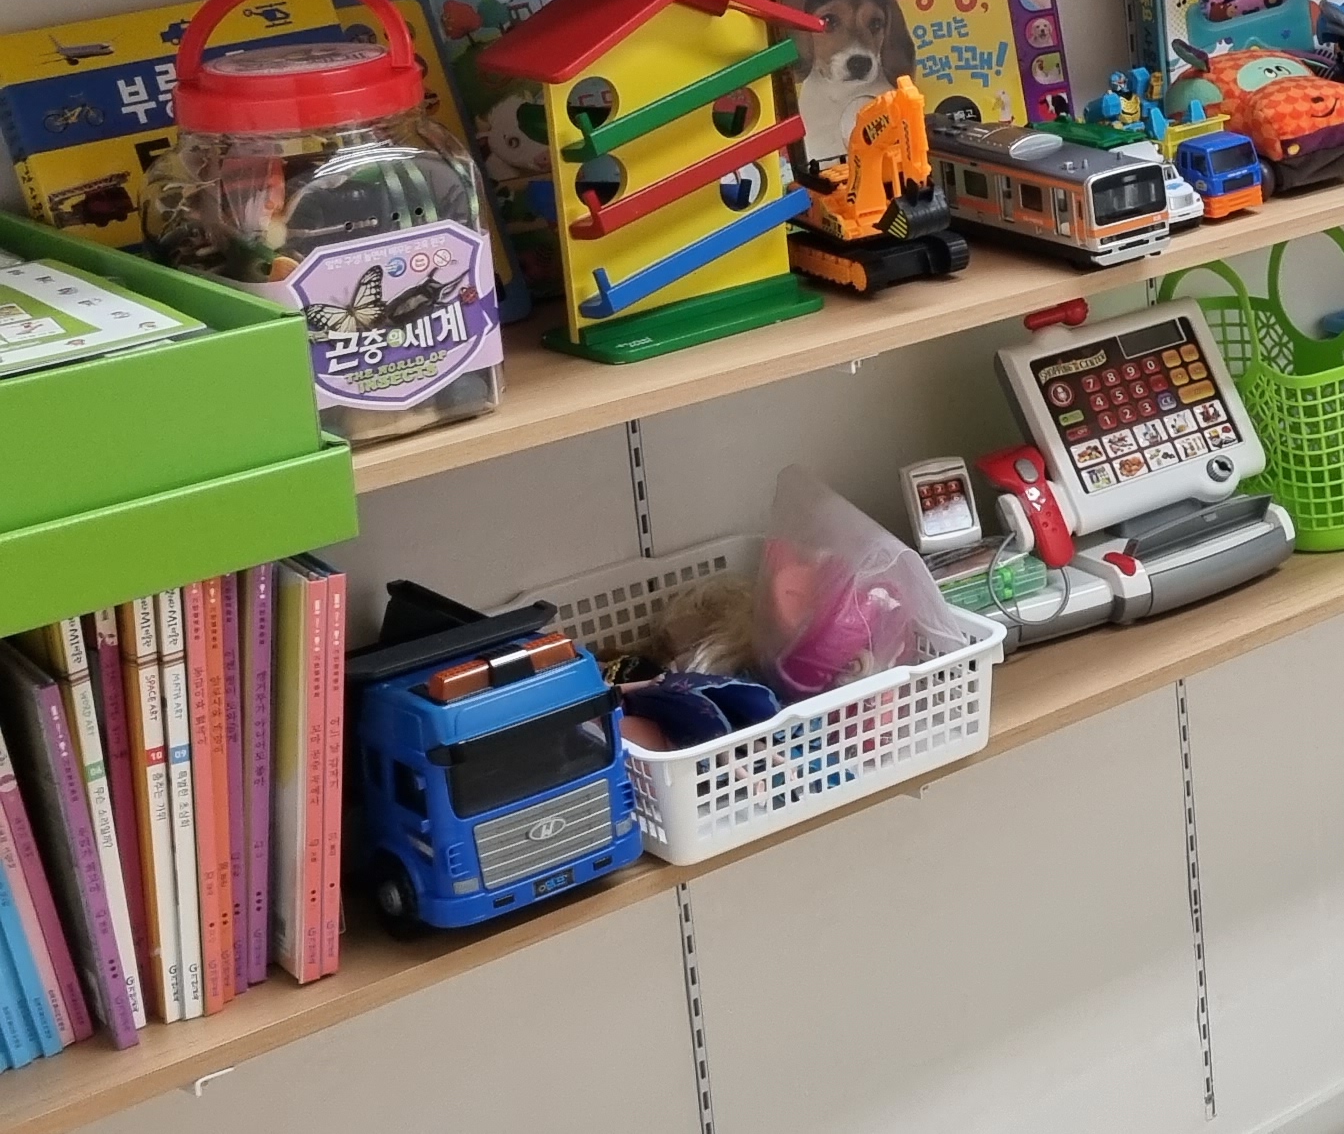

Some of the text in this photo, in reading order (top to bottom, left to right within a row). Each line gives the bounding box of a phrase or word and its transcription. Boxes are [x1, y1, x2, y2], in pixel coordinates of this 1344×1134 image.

[912, 16, 970, 49] 오리는
[344, 349, 448, 384] THE WORLD OF
[357, 363, 439, 394] INSECTS
[79, 690, 95, 737] WORD ART
[145, 674, 158, 722] SPACE ART
[171, 673, 183, 720] MATH ART
[150, 752, 162, 761] 10
[174, 750, 187, 759] 09
